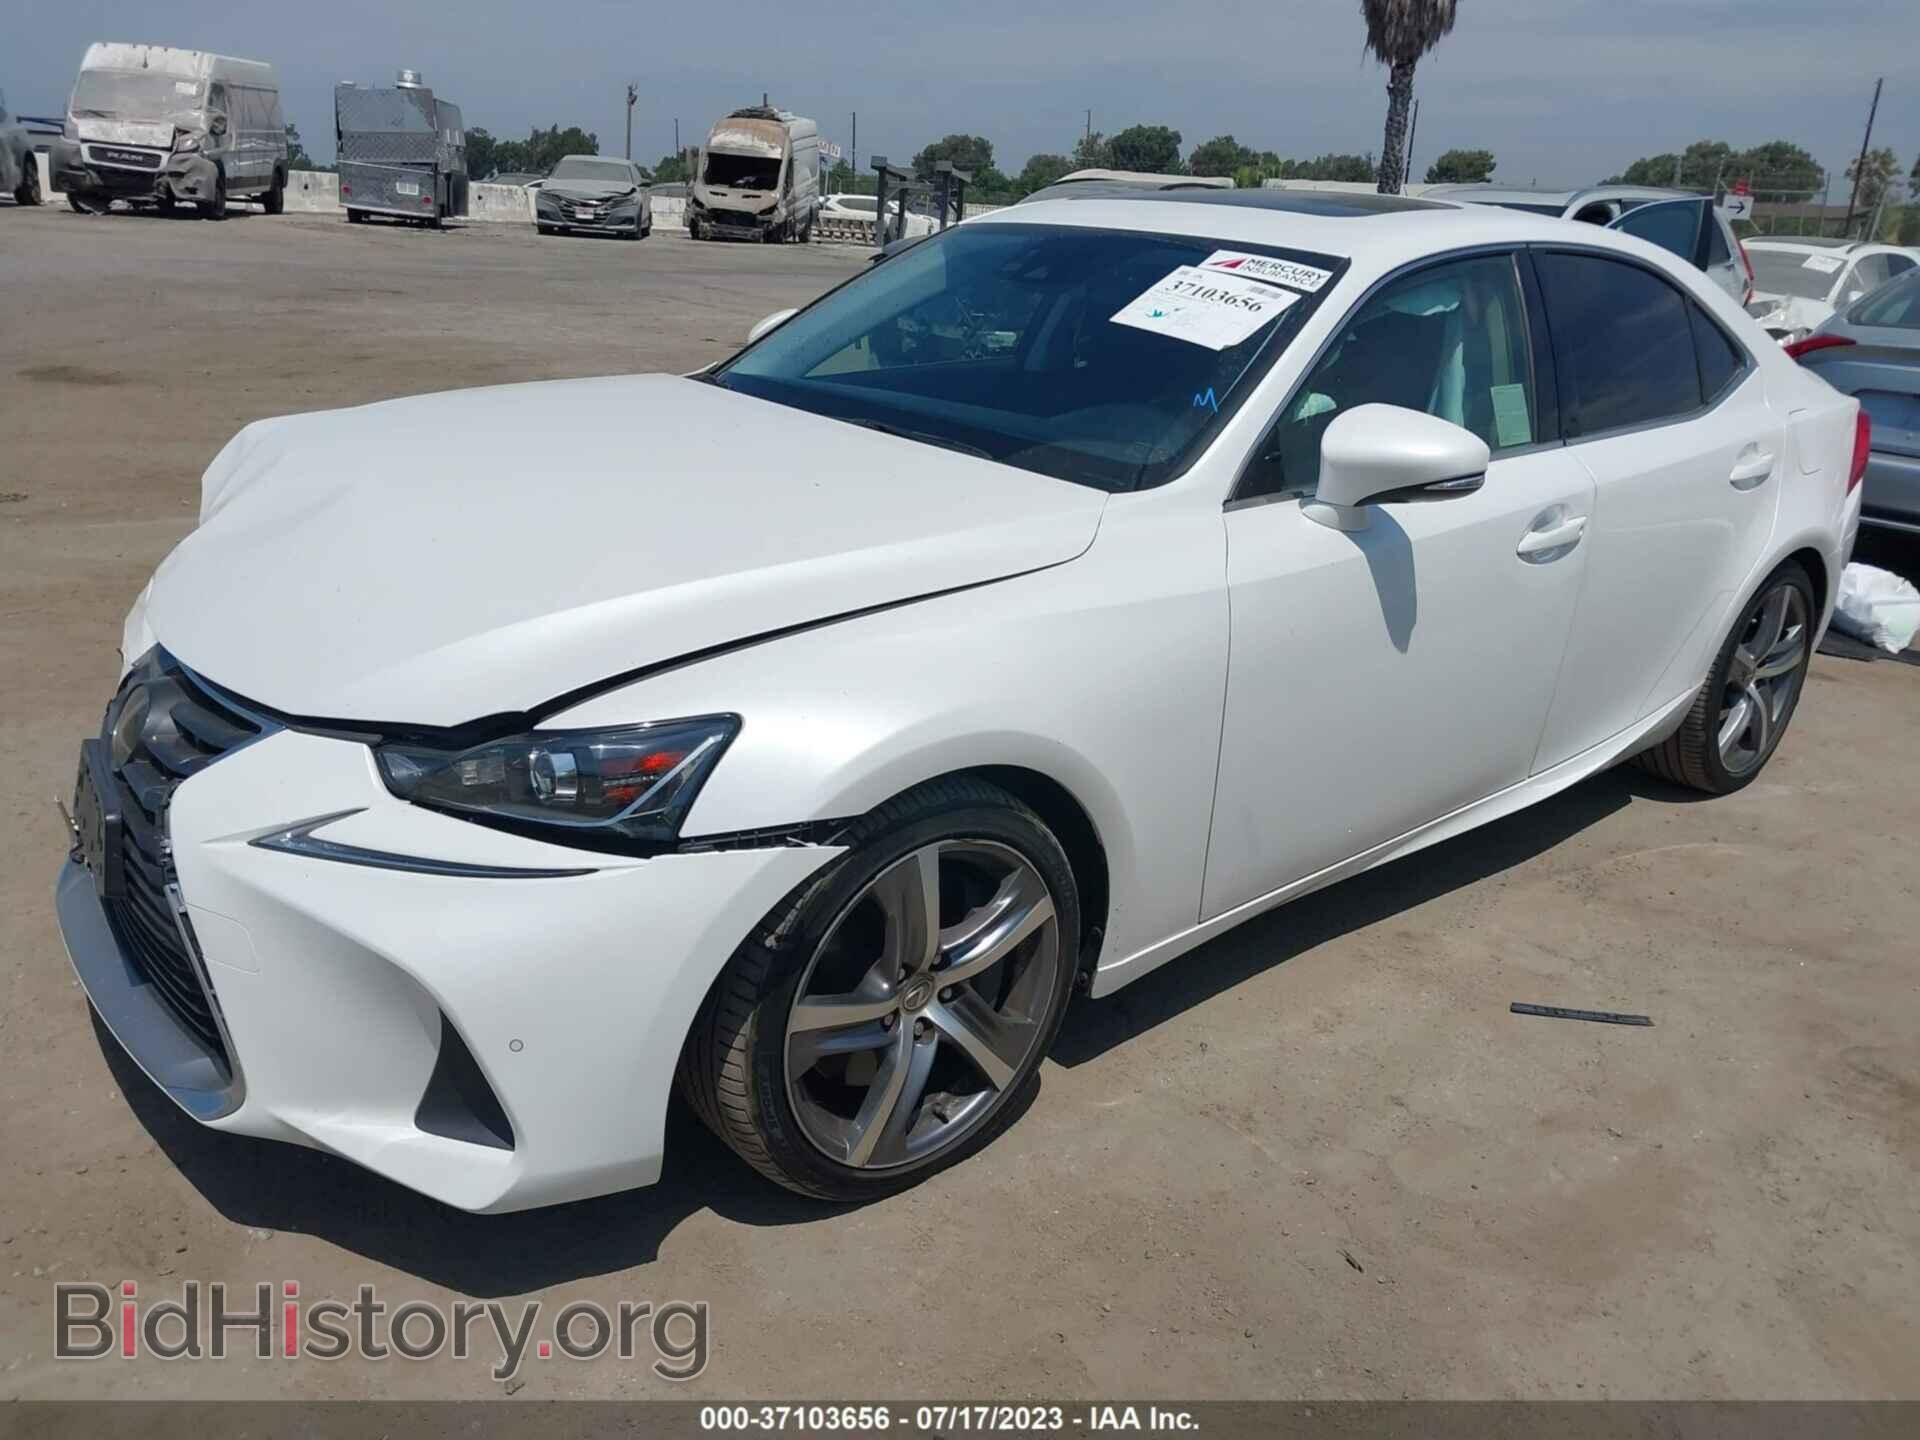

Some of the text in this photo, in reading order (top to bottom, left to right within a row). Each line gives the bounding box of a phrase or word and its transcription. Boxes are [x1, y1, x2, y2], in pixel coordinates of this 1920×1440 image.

[1243, 265, 1321, 287] INSURANCE
[1246, 258, 1327, 280] MERCURY
[1166, 280, 1263, 313] 37103656
